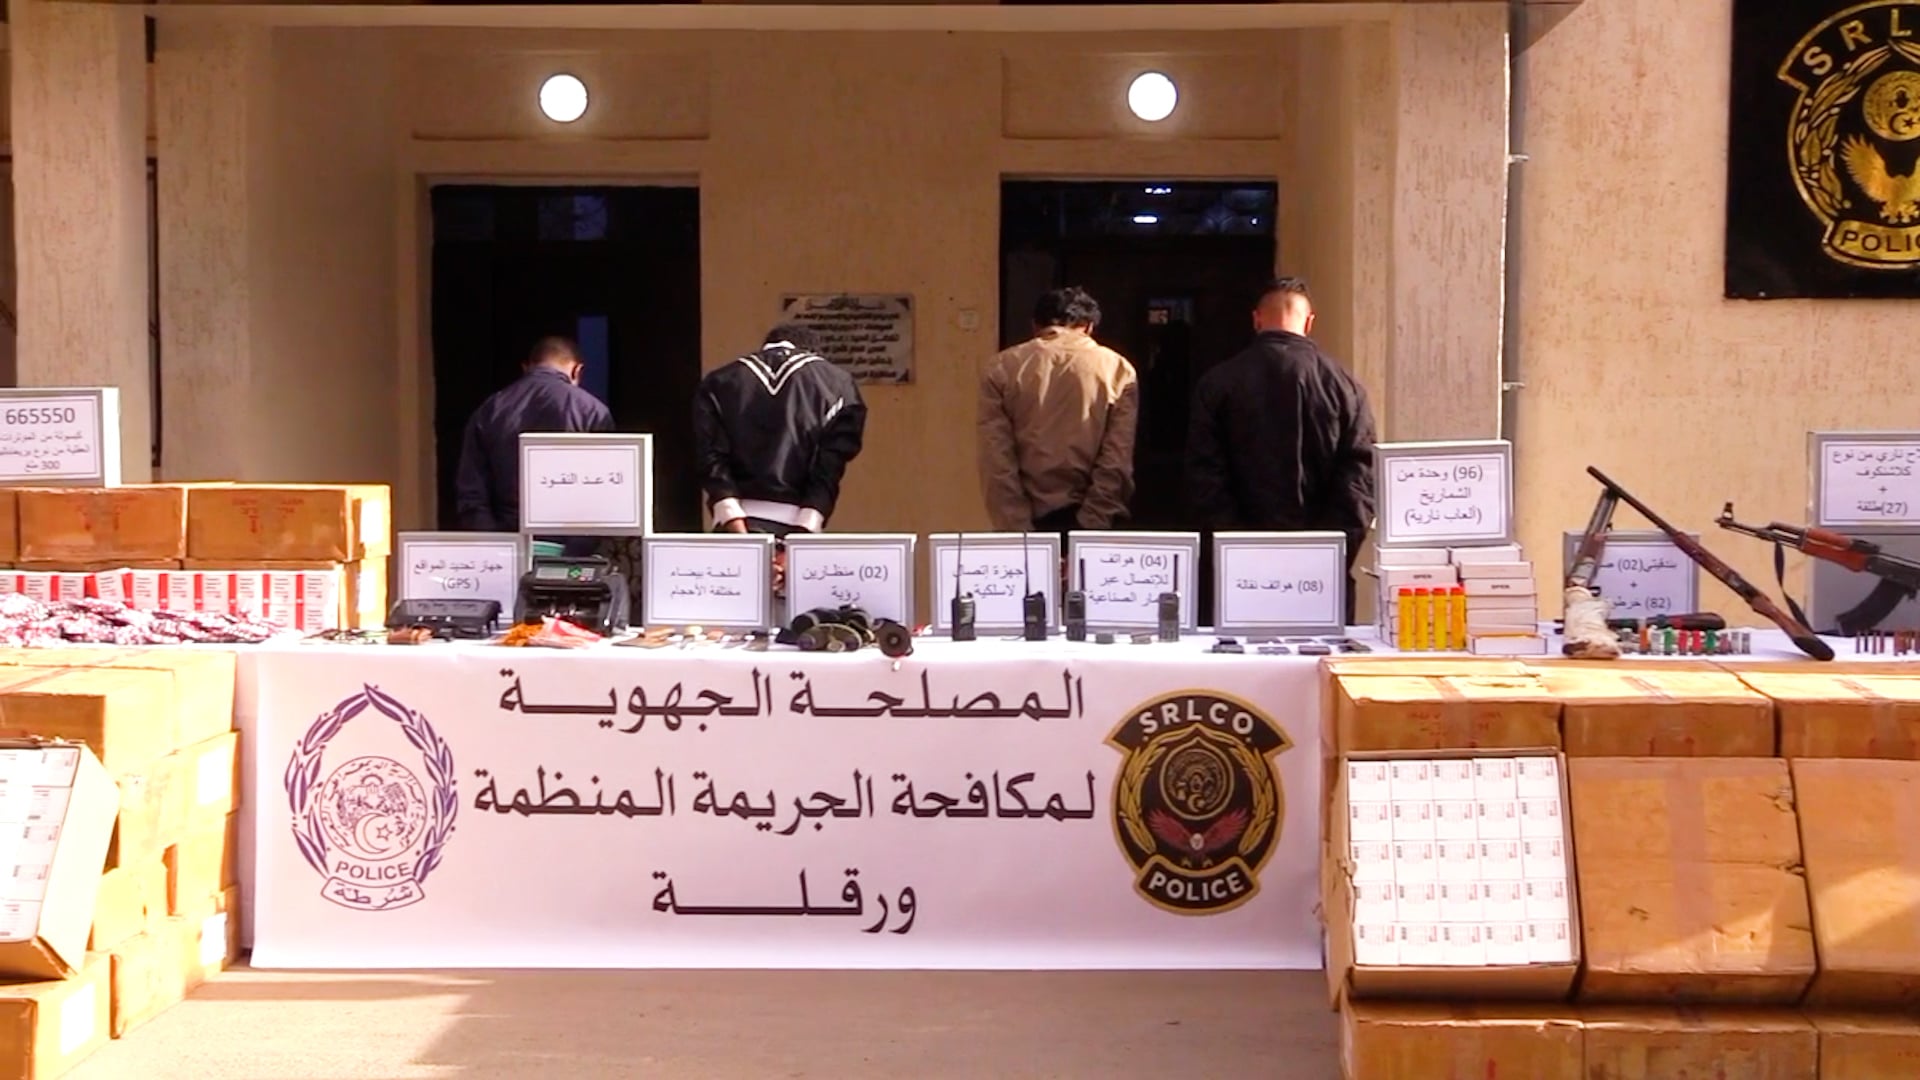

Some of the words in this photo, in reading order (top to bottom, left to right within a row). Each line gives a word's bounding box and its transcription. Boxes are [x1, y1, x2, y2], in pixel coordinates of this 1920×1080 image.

[1840, 229, 1920, 253] POLI
[5, 407, 76, 425] 665550
[41, 459, 61, 470] 300
[1833, 449, 1854, 464] نوع
[1857, 451, 1873, 462] من
[1397, 469, 1414, 482] من
[1418, 467, 1449, 481] وحدة
[1453, 465, 1483, 482] (96)
[1419, 486, 1471, 506] الشماريخ
[1140, 554, 1168, 570] (04)
[859, 564, 889, 582] (02)
[1298, 580, 1324, 595] (08)
[1645, 597, 1672, 611] (82)
[499, 666, 771, 734] الجهوية
[788, 667, 1084, 722] المصلحة
[1139, 700, 1254, 735] SRLCO
[473, 766, 676, 819] المنظمة
[890, 767, 1095, 822] لمكافحة
[693, 768, 874, 836] الجريمة
[335, 861, 412, 880] POLICE
[1148, 871, 1245, 901] POLICE
[651, 867, 918, 934] ورقلة
